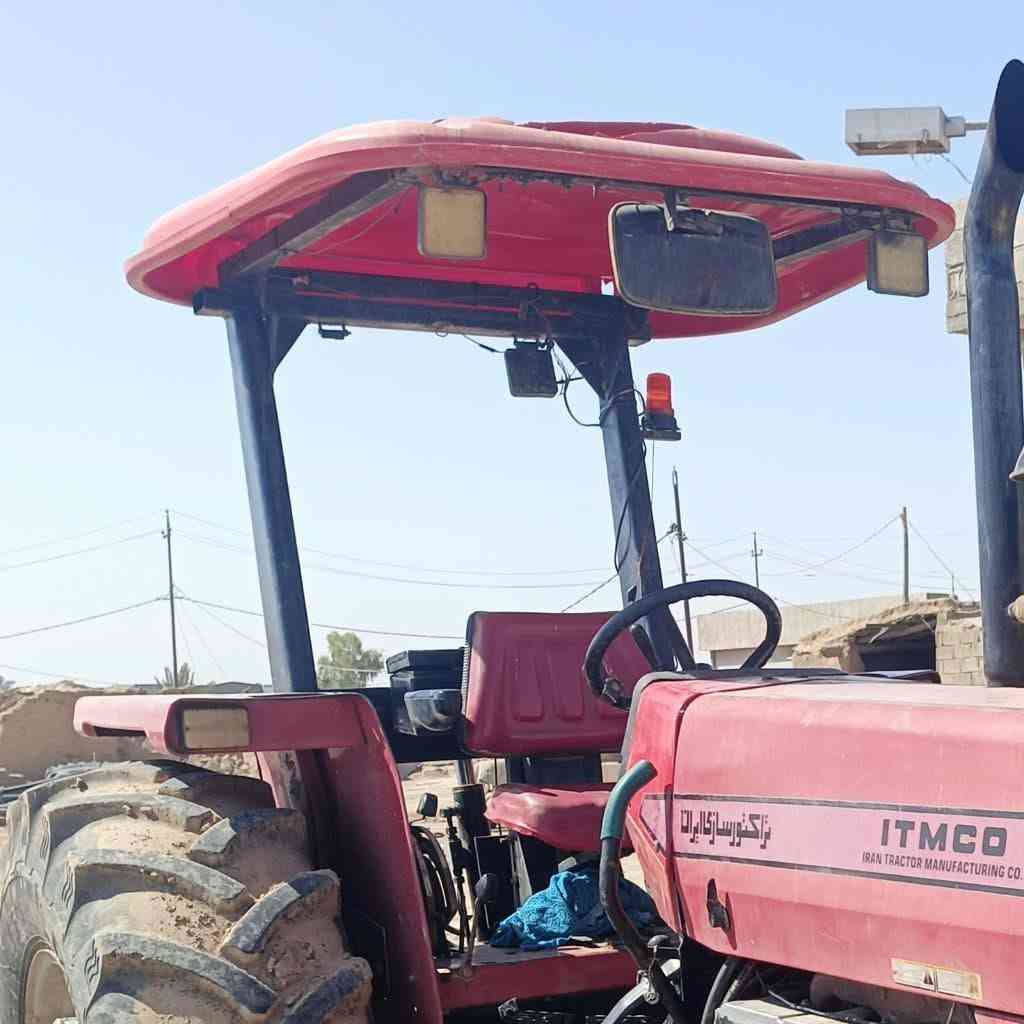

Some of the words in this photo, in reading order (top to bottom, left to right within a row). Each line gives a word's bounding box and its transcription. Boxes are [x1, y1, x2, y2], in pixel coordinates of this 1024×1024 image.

[881, 819, 1008, 857] ITMCO
[862, 850, 882, 865] IRAN
[884, 854, 922, 869] TRACTOR
[924, 857, 1006, 878] MANUFACTURING
[1007, 866, 1023, 880] CO.
